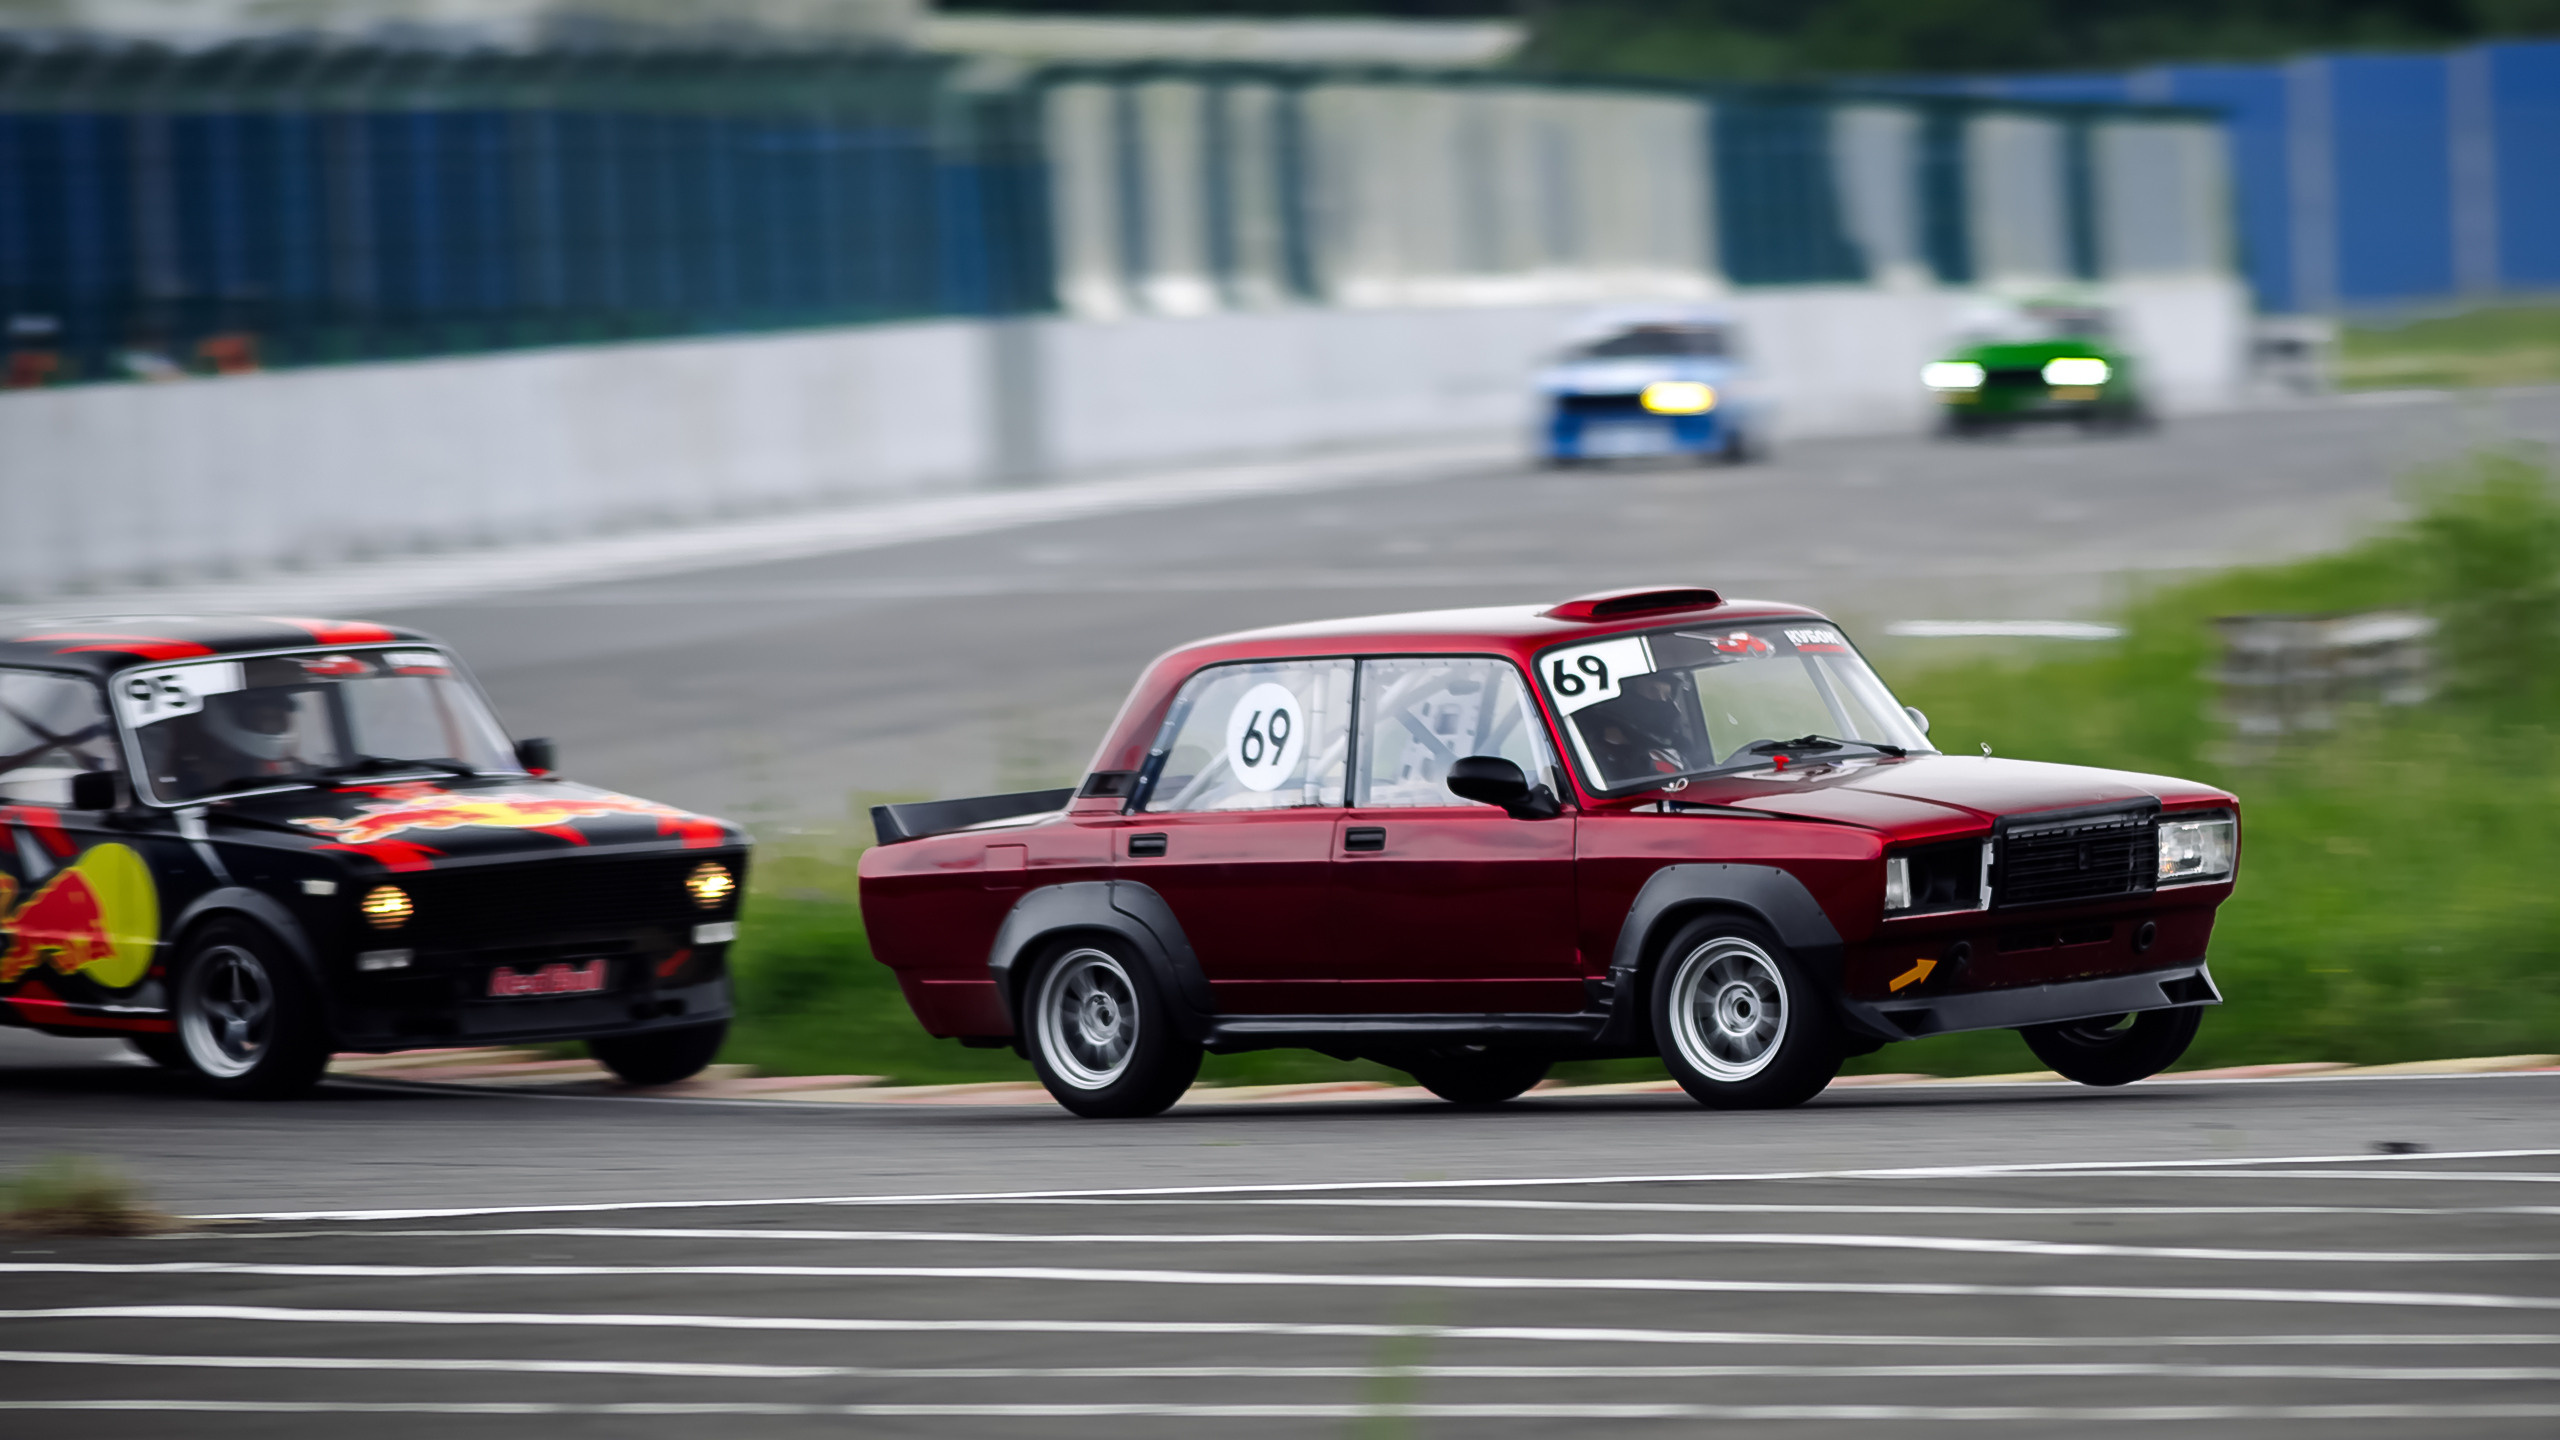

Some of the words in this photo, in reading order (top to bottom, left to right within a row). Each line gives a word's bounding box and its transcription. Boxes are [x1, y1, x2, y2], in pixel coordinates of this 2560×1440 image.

[1783, 629, 1840, 645] КУБОК
[125, 675, 187, 714] 95
[1553, 655, 1608, 697] 69
[1241, 708, 1291, 768] 69
